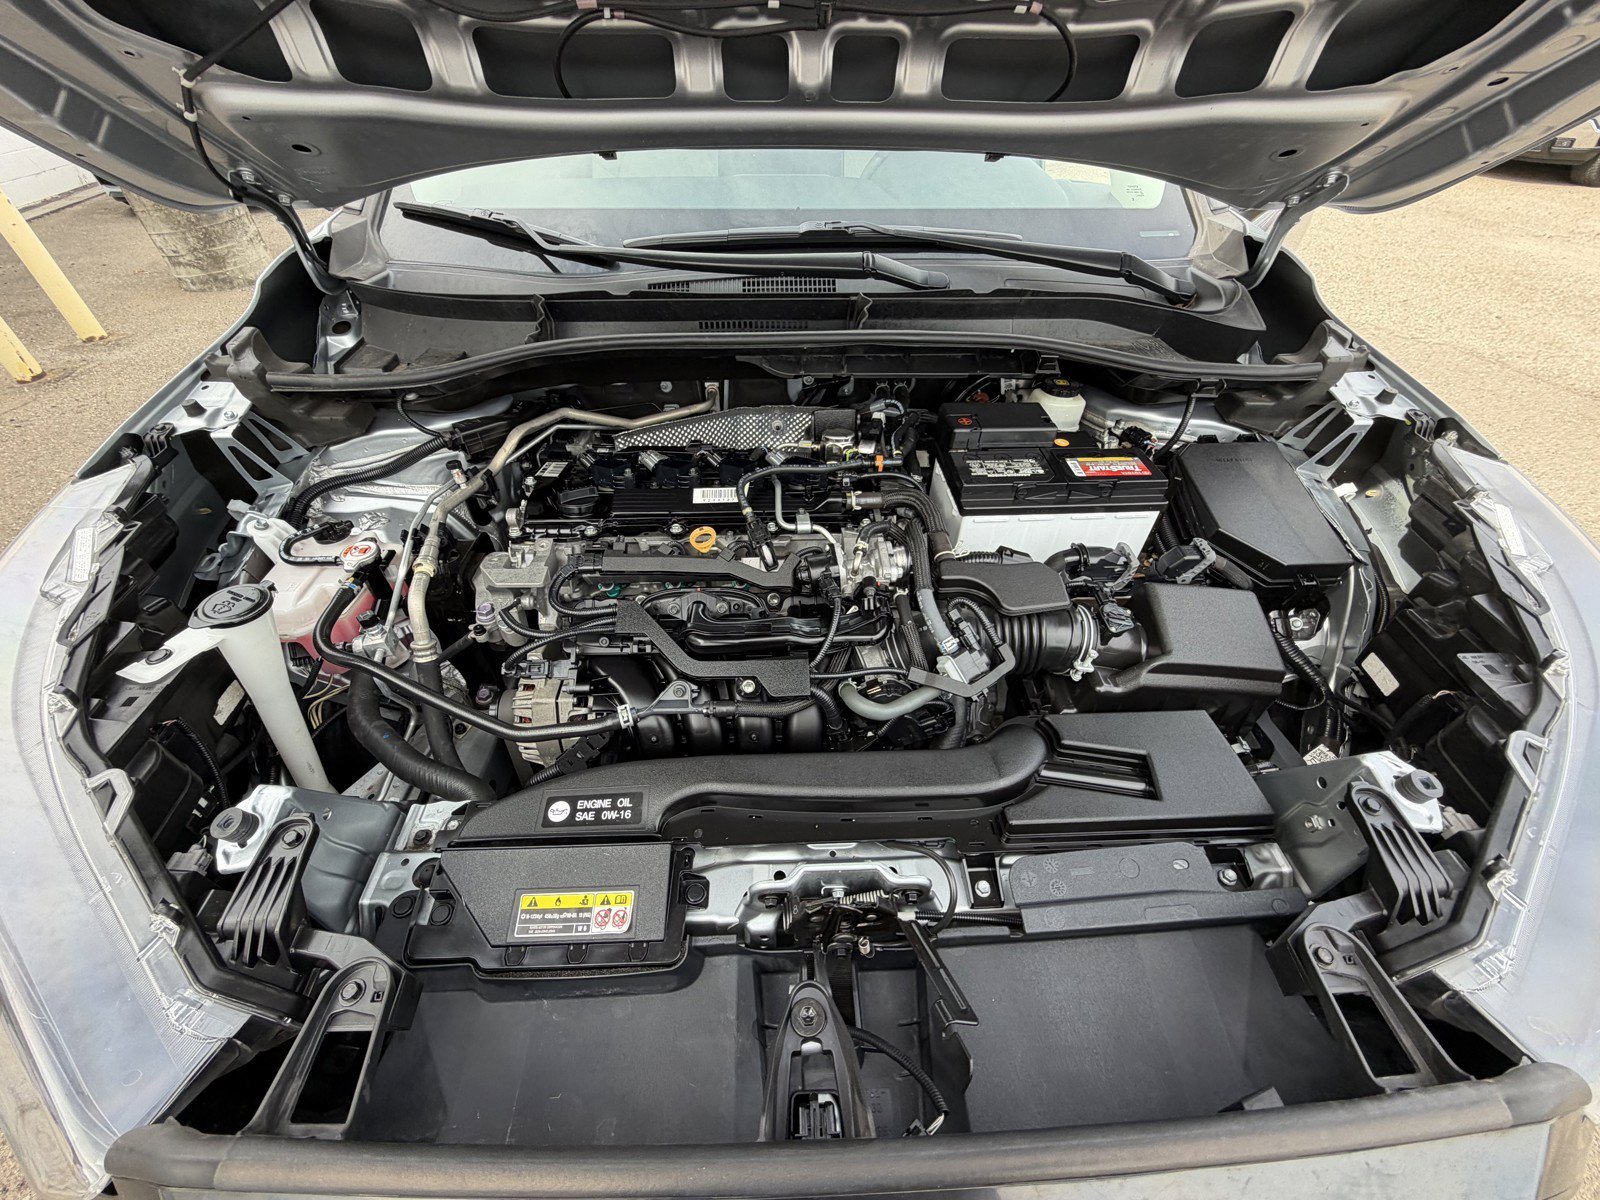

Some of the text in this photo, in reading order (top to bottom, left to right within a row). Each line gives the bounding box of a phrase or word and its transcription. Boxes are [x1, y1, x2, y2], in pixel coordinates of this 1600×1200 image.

[577, 797, 633, 809] ENGINE OIL
[575, 810, 632, 821] SAE 0W-16
